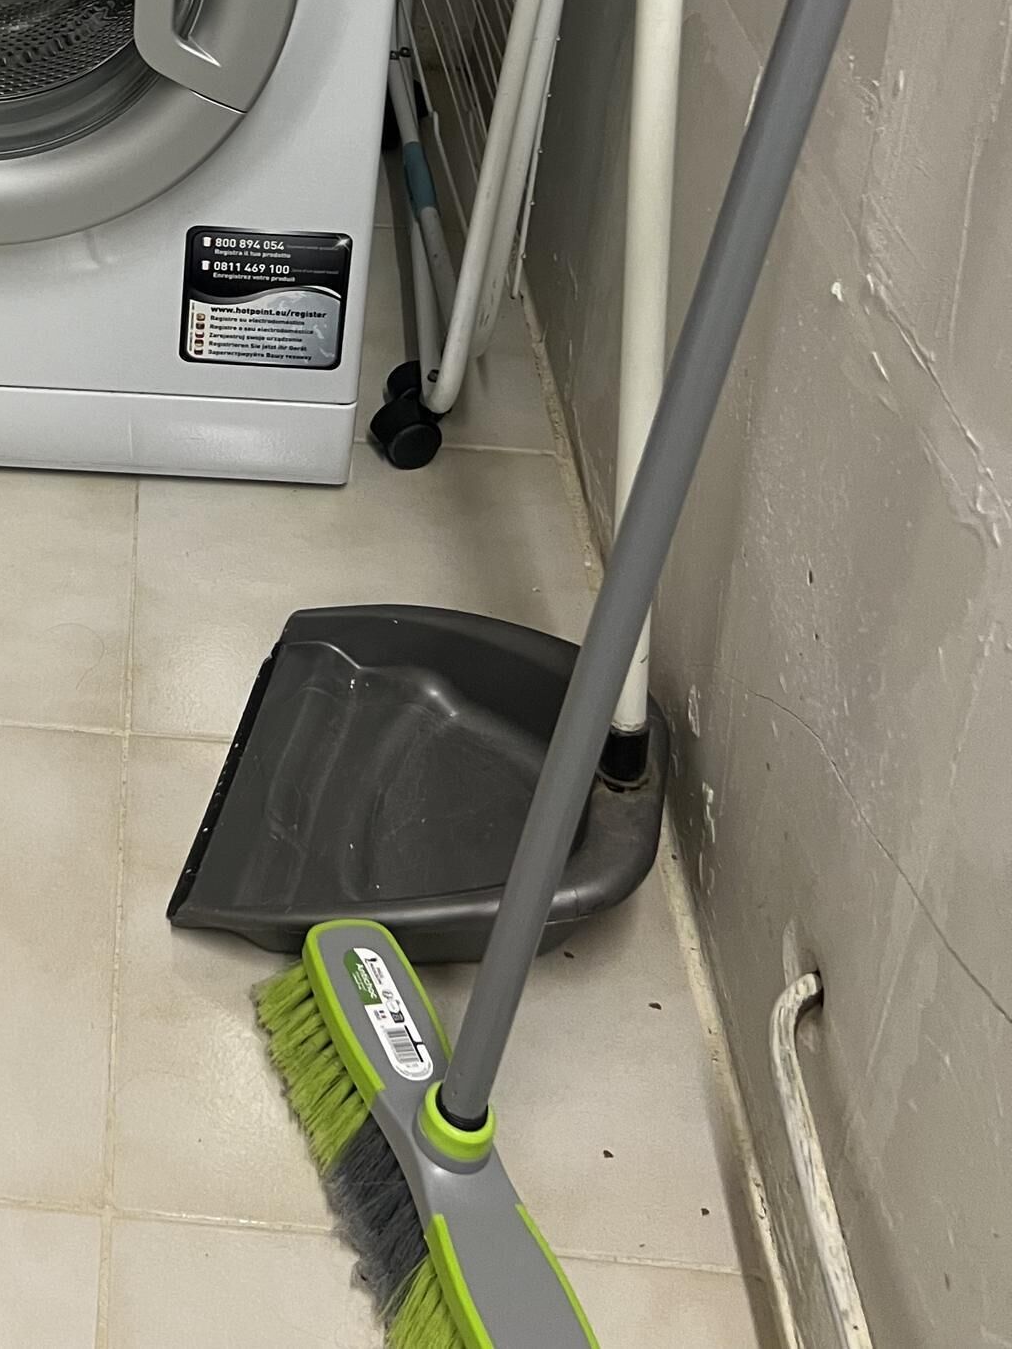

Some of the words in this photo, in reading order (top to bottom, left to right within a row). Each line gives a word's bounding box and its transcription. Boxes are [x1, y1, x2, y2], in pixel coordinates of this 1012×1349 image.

[215, 238, 236, 248] 800
[239, 239, 261, 249] 894
[263, 240, 285, 250] 054
[214, 261, 241, 271] 0811
[244, 263, 266, 273] 469
[269, 265, 290, 274] 100
[211, 307, 327, 318] www.hotpoint.eu/register
